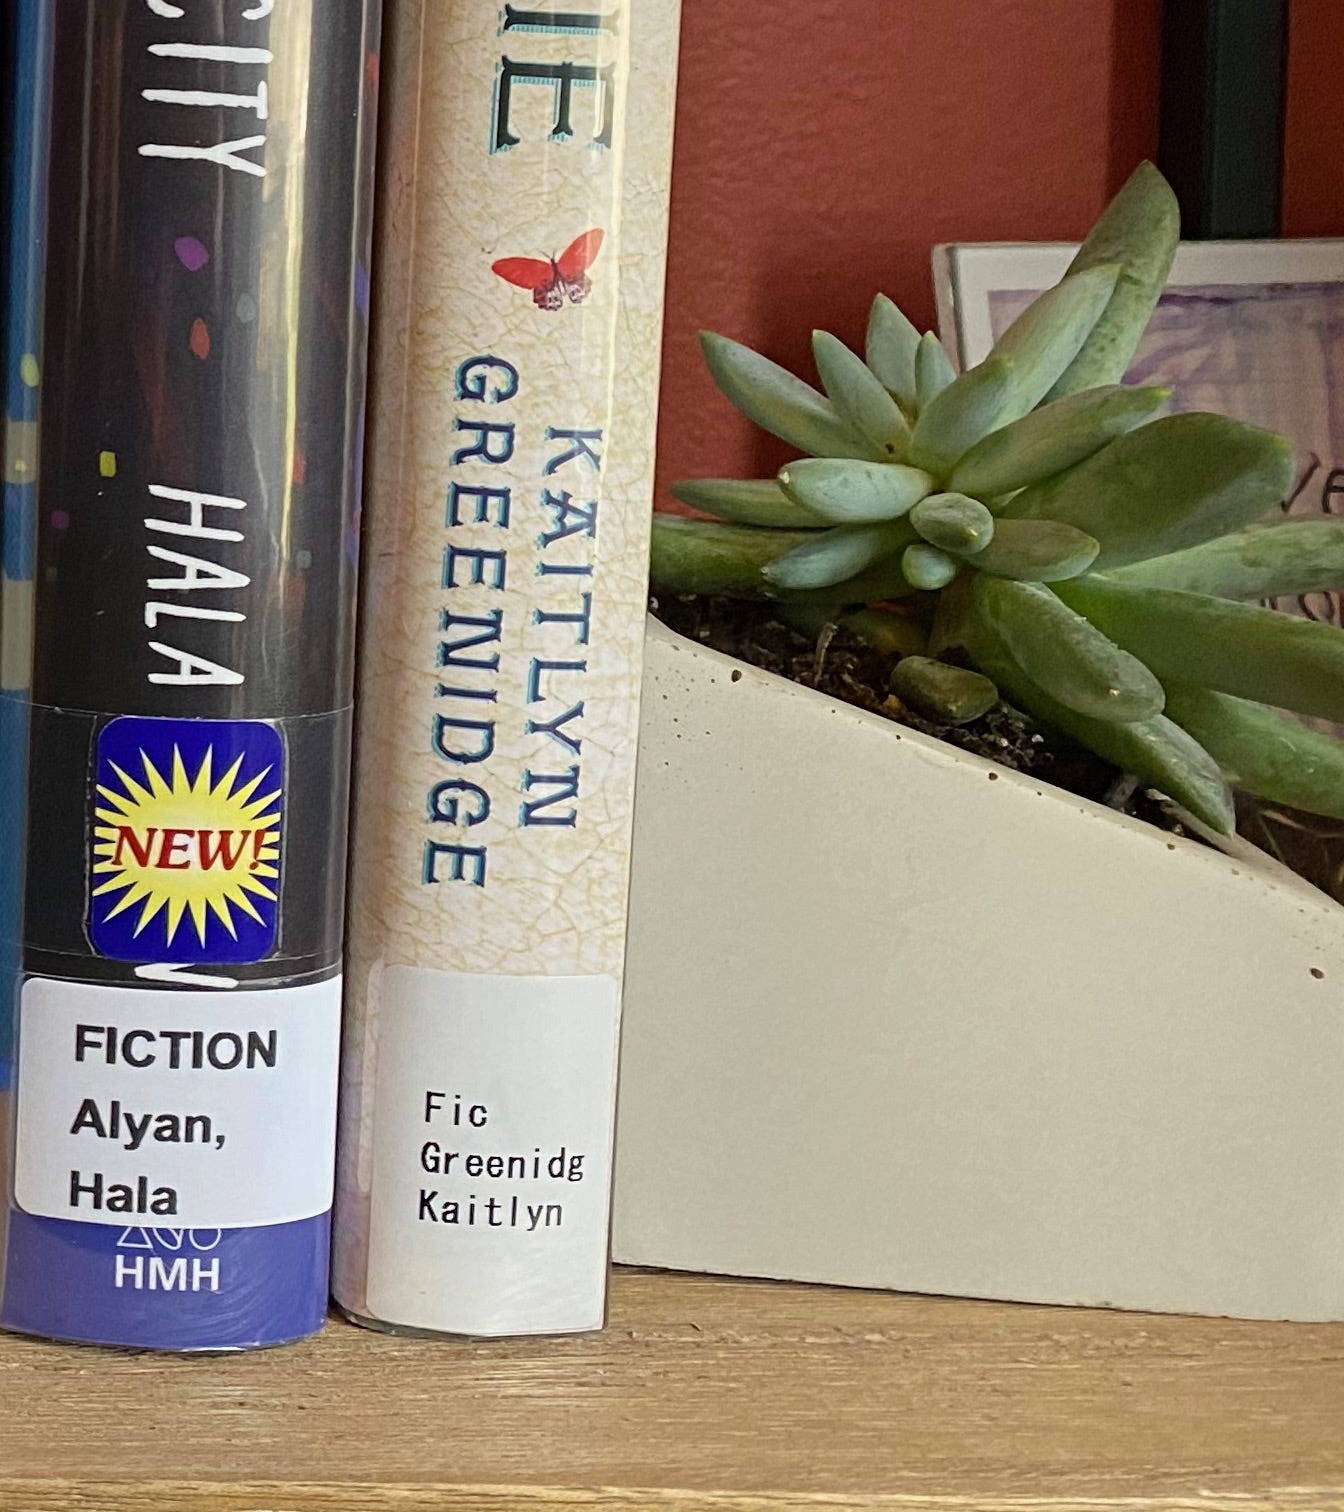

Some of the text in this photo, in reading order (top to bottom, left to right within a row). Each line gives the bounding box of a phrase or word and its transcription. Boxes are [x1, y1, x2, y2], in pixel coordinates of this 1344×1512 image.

[144, 483, 251, 686] HALA
[421, 354, 521, 888] GREENIDGE
[519, 425, 604, 829] KAITLYN
[112, 825, 268, 872] NEW!
[75, 1024, 278, 1070] FICTION
[70, 1098, 226, 1151] Alyan,
[424, 1091, 488, 1128] Fic
[420, 1142, 585, 1182] Greenidg
[70, 1169, 178, 1216] Hala
[418, 1190, 563, 1231] Kaitlyn
[114, 1254, 220, 1292] HMH
